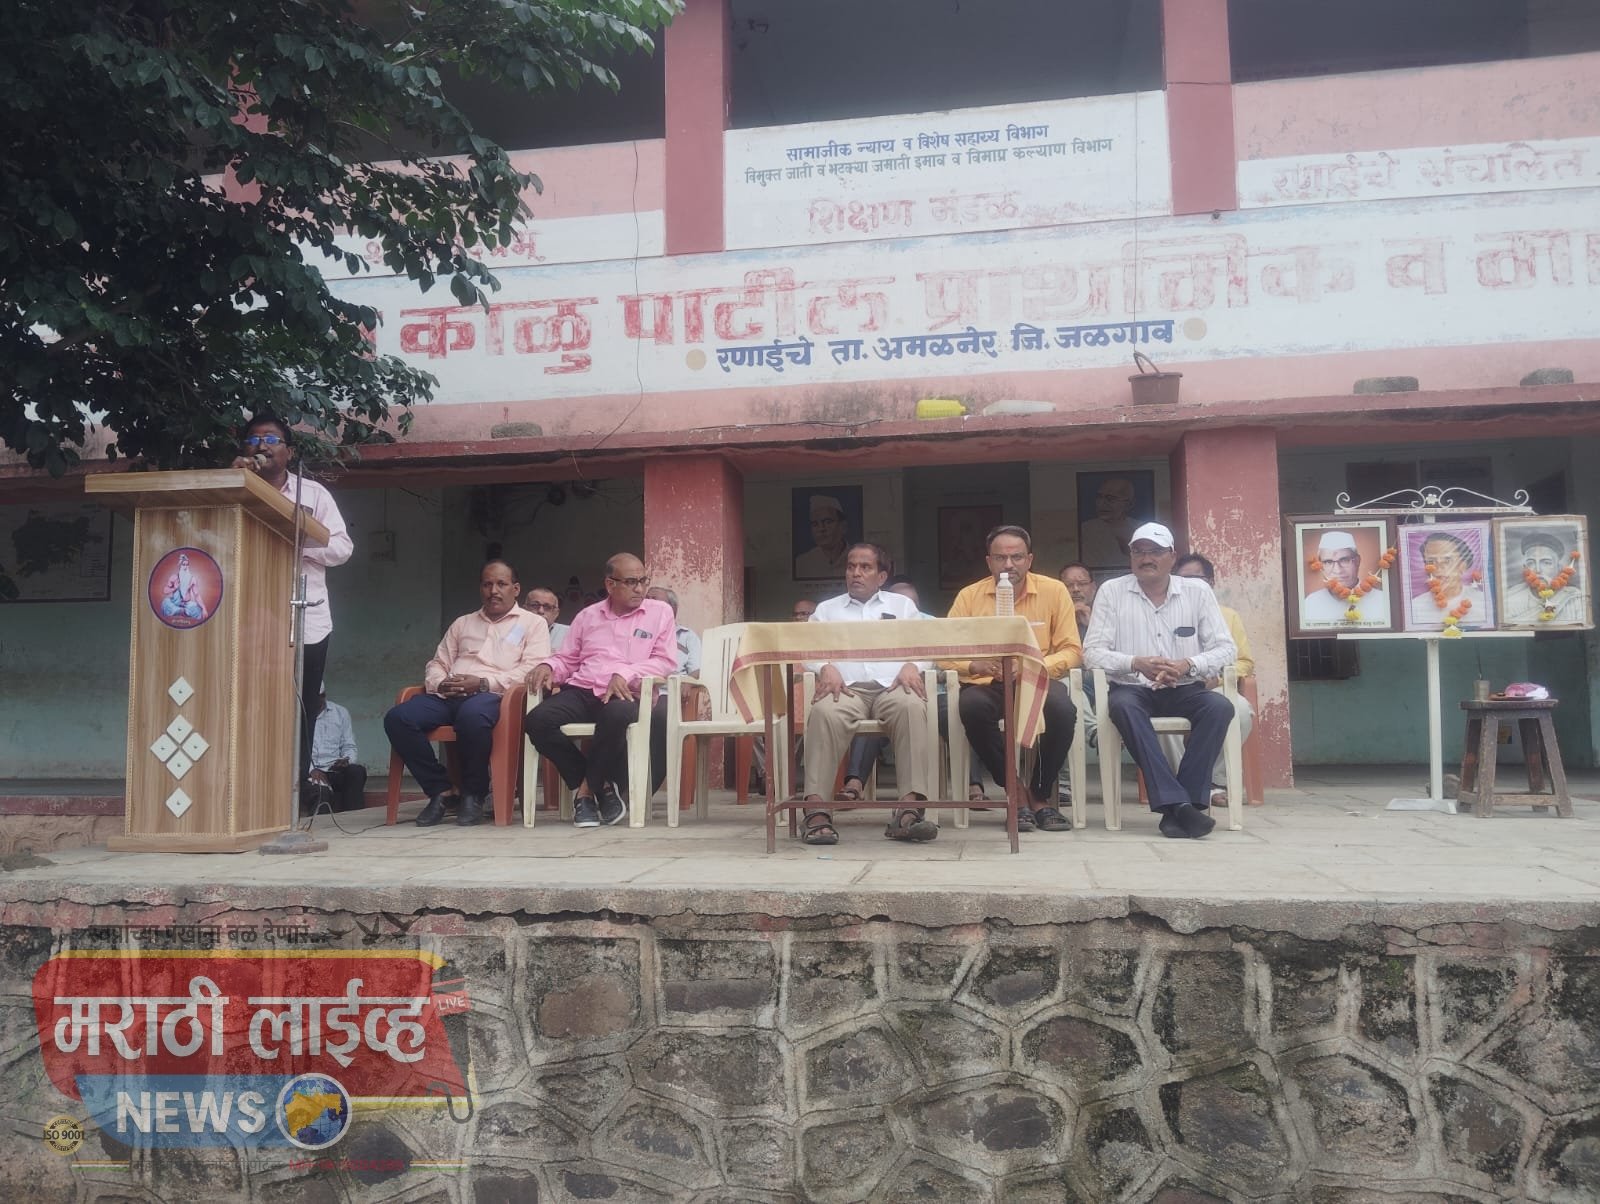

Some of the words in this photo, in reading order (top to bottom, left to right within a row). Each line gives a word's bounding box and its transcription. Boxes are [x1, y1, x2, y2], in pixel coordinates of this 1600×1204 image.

[744, 167, 783, 187] विमुक्त
[785, 162, 813, 180] जाती
[816, 163, 827, 177] व
[871, 153, 911, 173] जमाती
[951, 152, 963, 166] व
[1013, 142, 1067, 160] कल्याण
[1071, 137, 1113, 154] विभाग
[786, 139, 853, 162] सामाजीक
[857, 139, 896, 154] न्याय
[902, 138, 914, 151] व
[917, 131, 950, 149] विशेष
[1005, 124, 1050, 142] विभाग
[400, 296, 599, 375] काळु
[616, 267, 897, 346] पाटील
[715, 335, 815, 373] रणाईचे
[827, 338, 868, 365] ता.
[872, 326, 999, 360] अमळनेर
[1011, 322, 1050, 351] जि.
[1053, 319, 1175, 349] जळगाव
